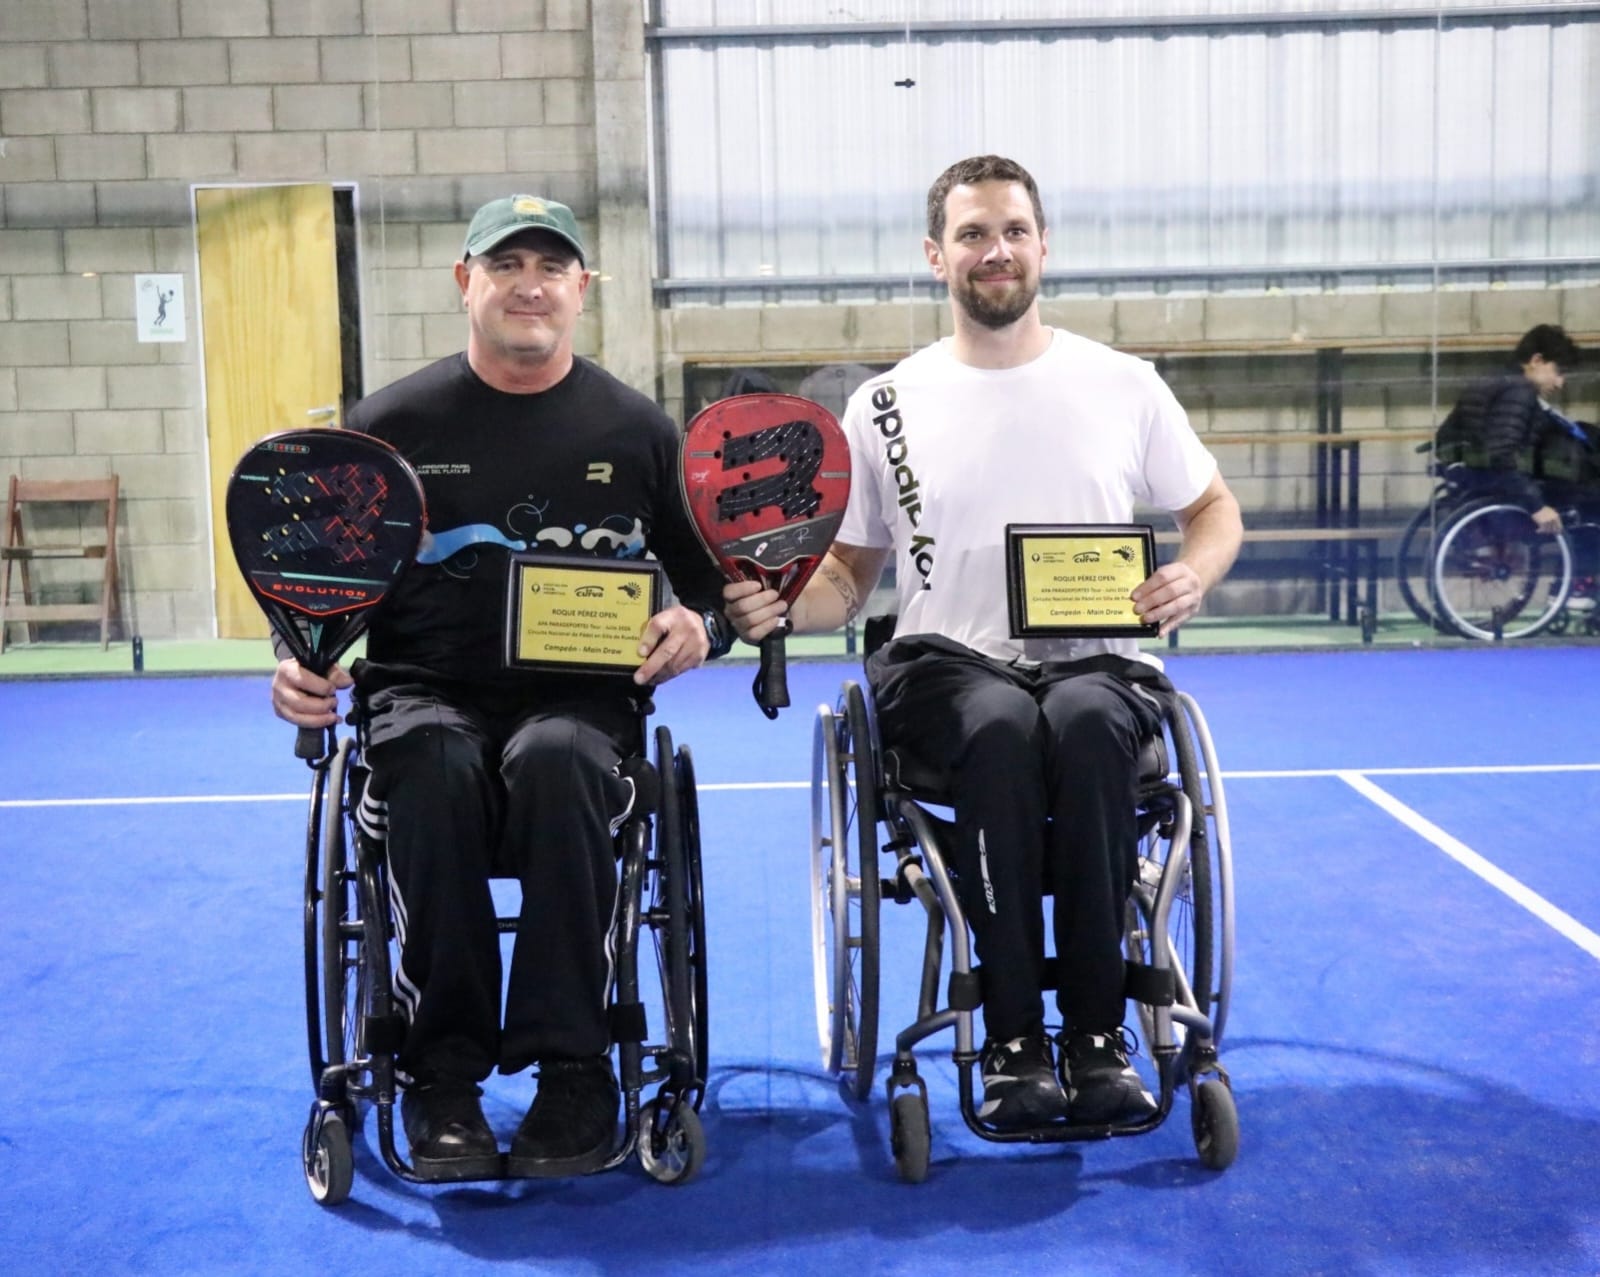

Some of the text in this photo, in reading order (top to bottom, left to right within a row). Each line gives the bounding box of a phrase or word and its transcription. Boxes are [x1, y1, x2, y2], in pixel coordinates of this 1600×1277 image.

[1077, 574, 1097, 582] PÉREZ
[272, 584, 367, 597] EVOLUTION
[552, 609, 575, 617] ROQUE
[577, 609, 598, 618] PÉREZ
[583, 646, 601, 654] Main
[603, 647, 622, 655] Draw
